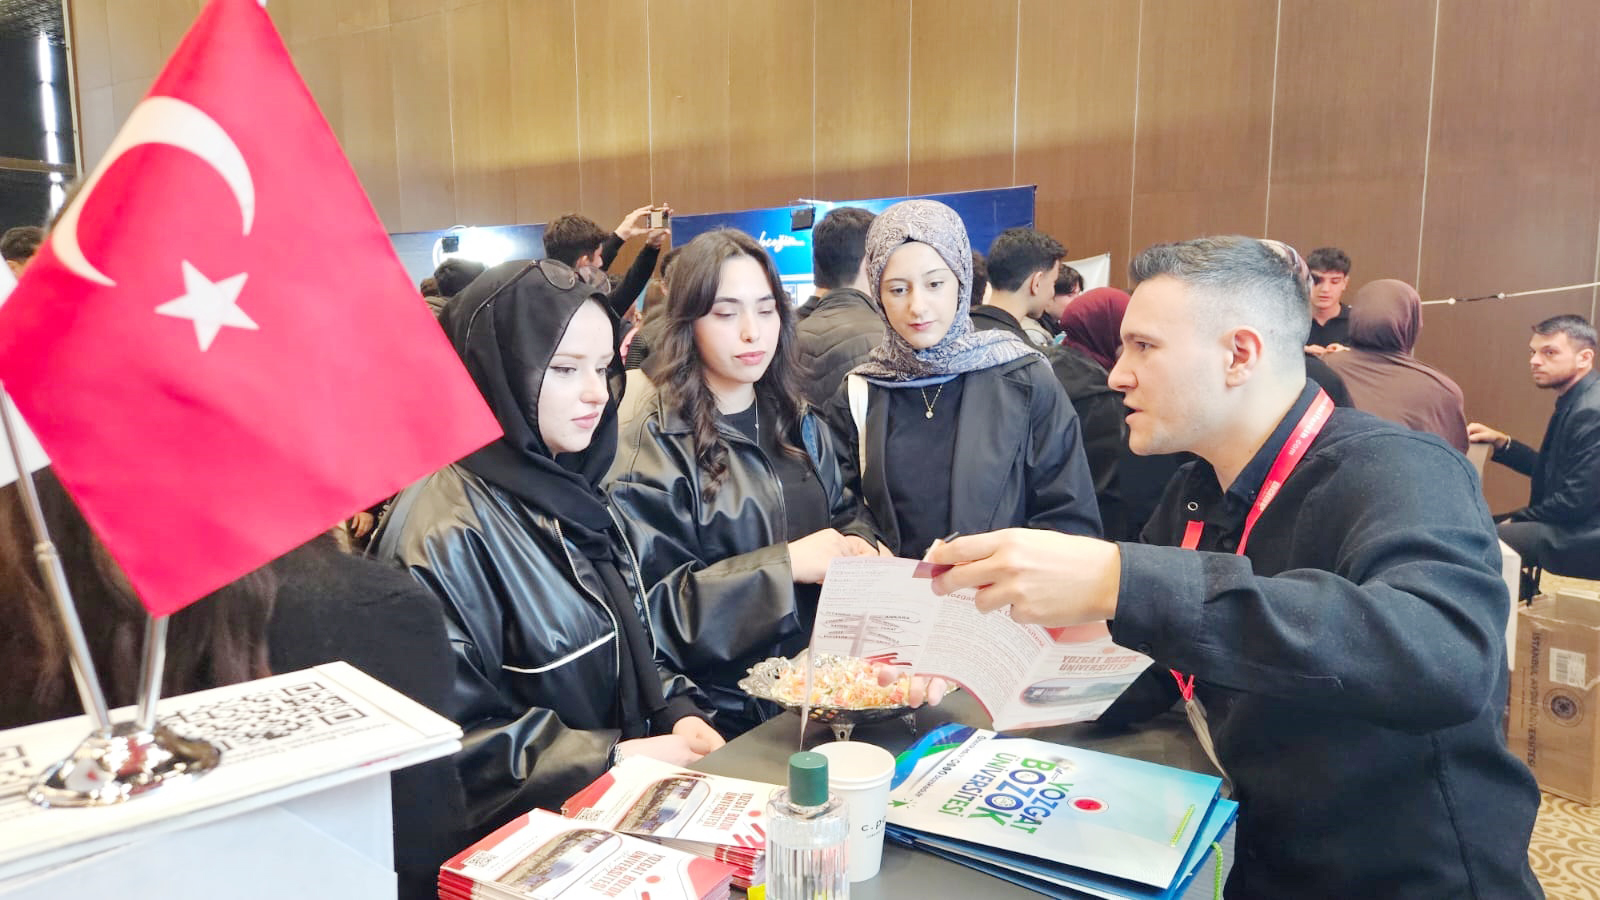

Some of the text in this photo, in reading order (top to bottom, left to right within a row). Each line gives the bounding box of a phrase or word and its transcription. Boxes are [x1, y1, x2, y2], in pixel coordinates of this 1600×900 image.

[1062, 655, 1102, 664] YOZGAT
[938, 752, 1021, 817] ÜNİVERSİTESİ
[968, 757, 1057, 826] BOZOK
[731, 792, 754, 812] YOZGAT
[1010, 782, 1074, 834] YOZGAT
[630, 853, 666, 876] YOZGAT
[602, 874, 637, 898] BOZOK
